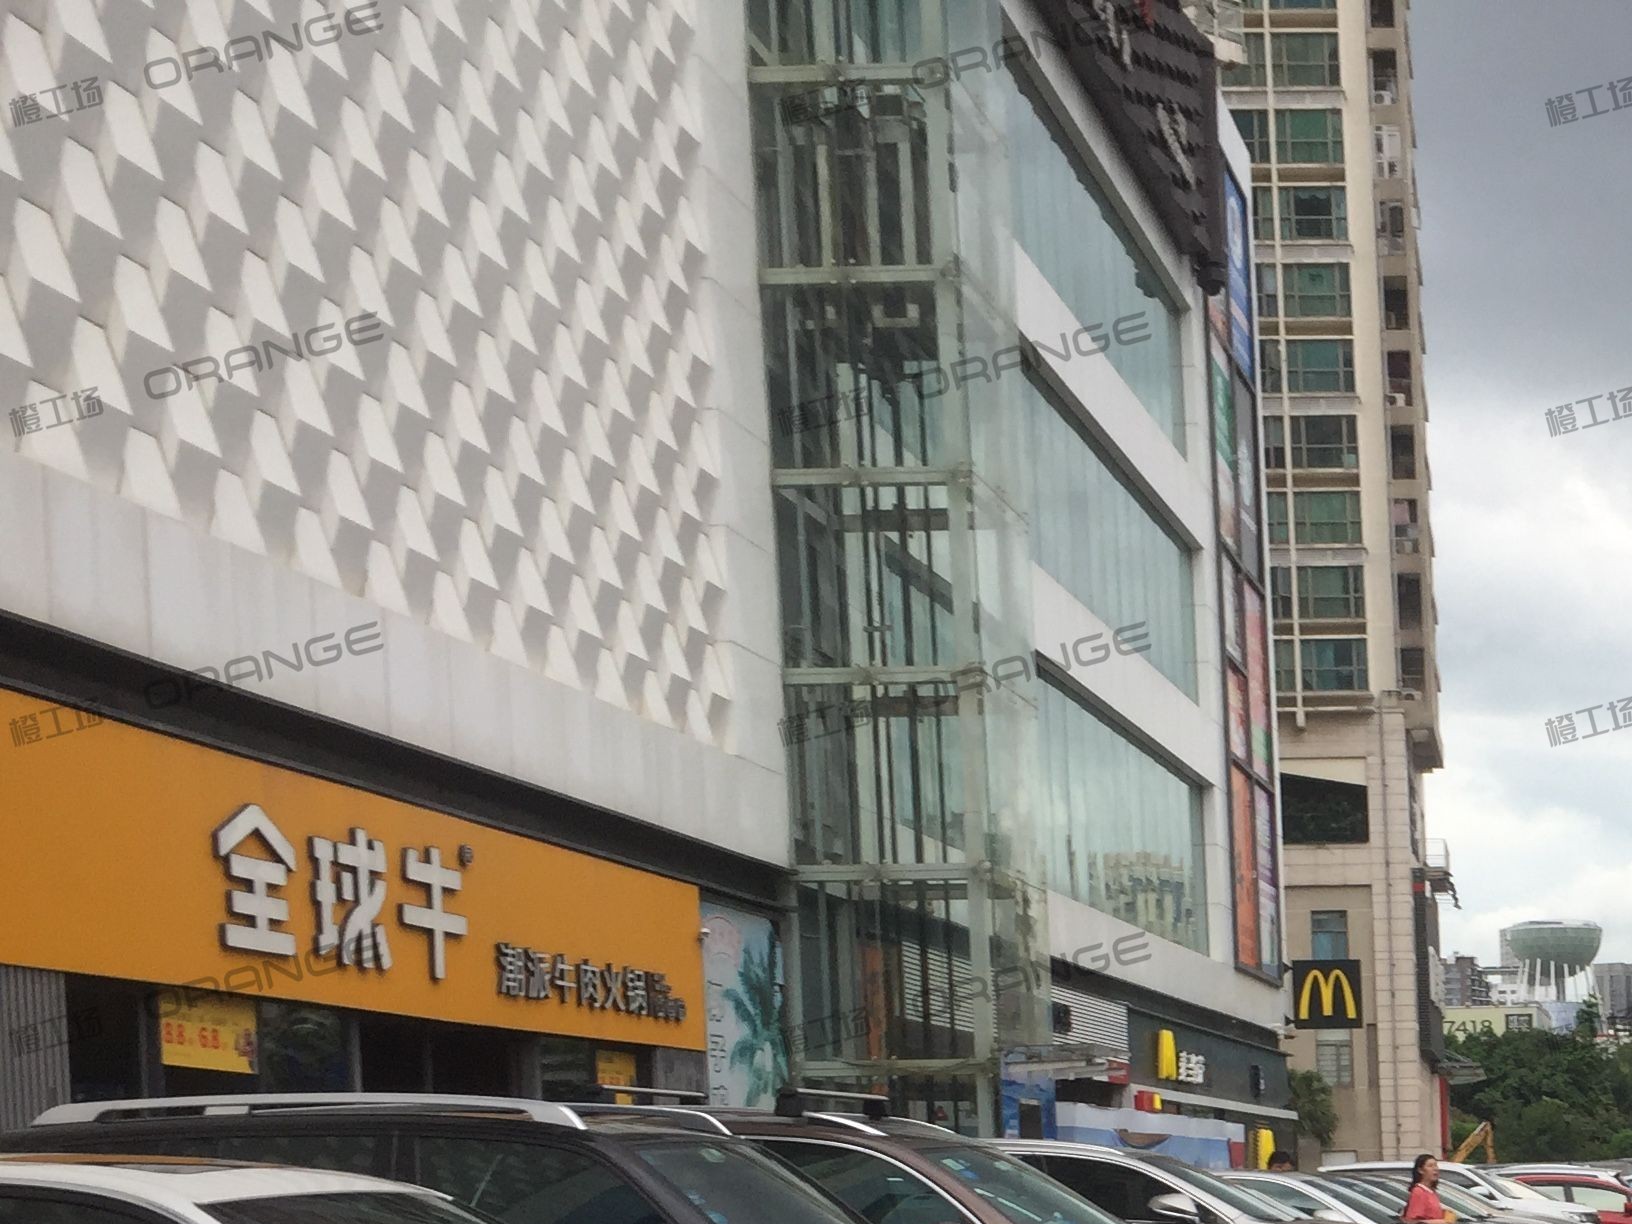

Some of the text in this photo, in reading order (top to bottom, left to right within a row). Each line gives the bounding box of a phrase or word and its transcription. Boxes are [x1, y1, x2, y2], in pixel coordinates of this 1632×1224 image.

[214, 803, 469, 982] 全球牛
[497, 943, 649, 1017] 潮派牛肉火锅
